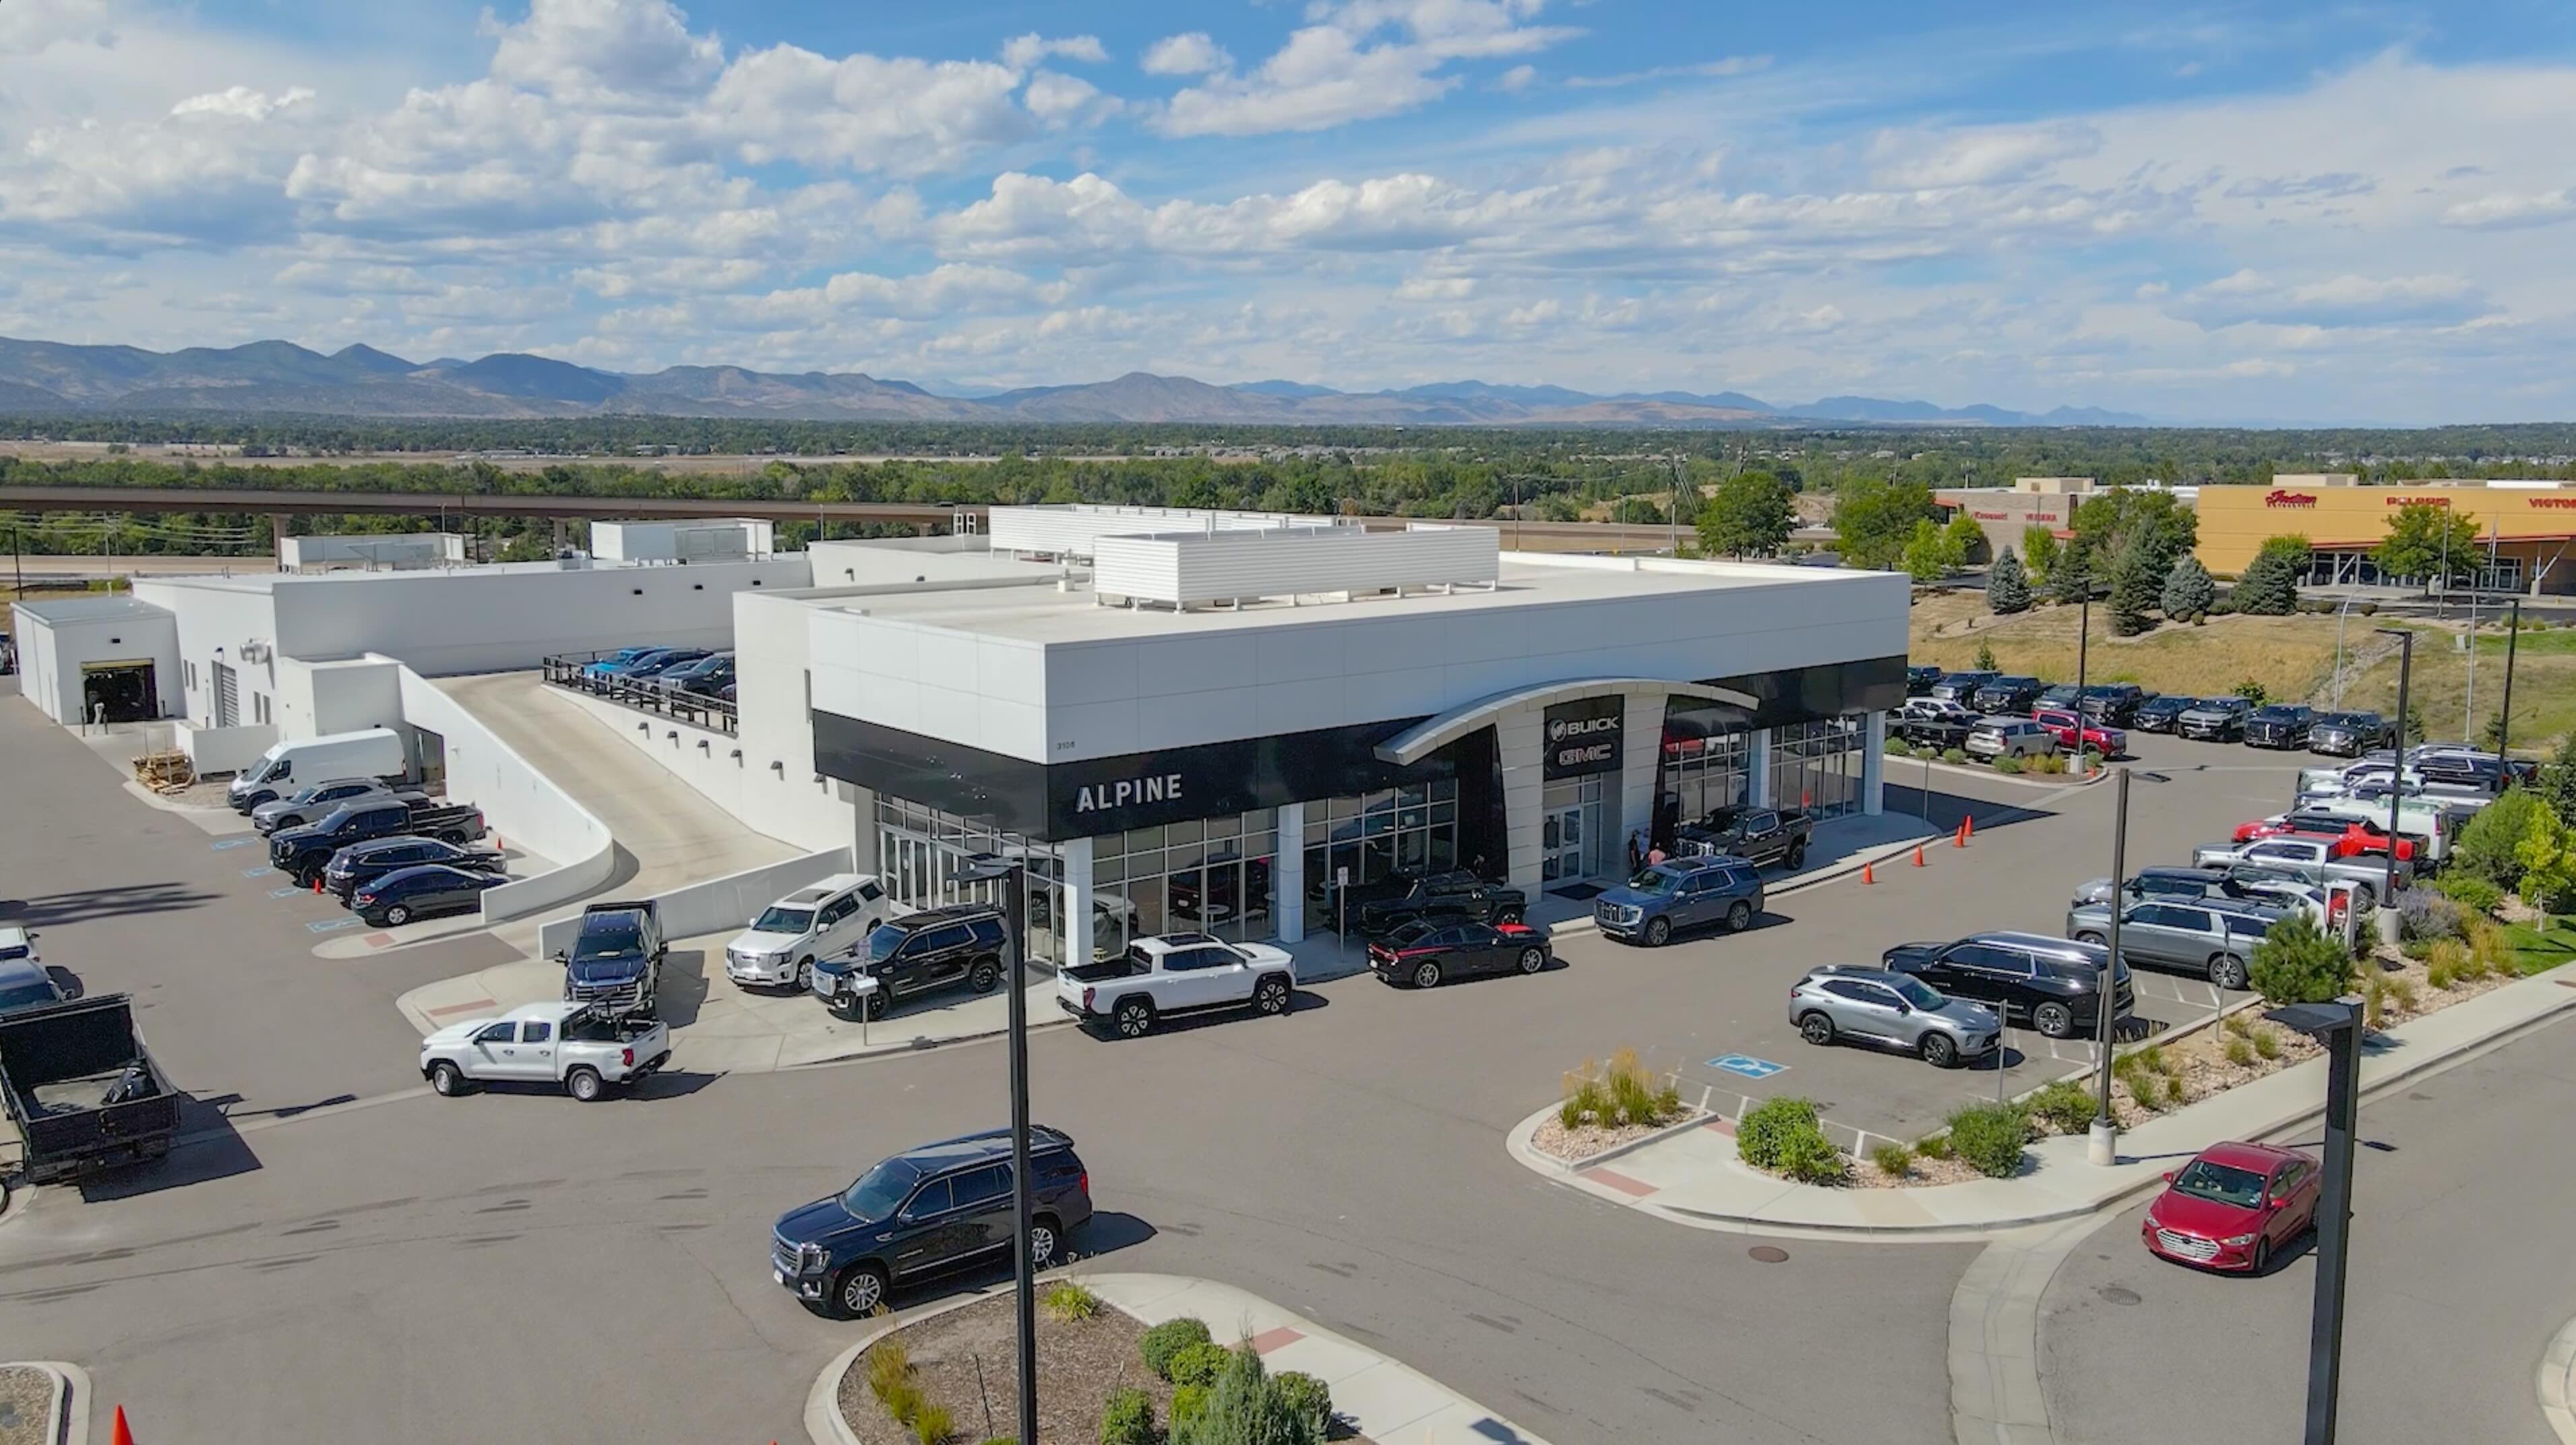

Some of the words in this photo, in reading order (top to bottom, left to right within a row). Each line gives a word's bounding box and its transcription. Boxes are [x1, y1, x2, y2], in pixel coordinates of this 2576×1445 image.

[2387, 497, 2449, 505] POLARIS
[1567, 716, 1619, 735] BUICK
[1559, 743, 1612, 766] GMC
[1076, 774, 1182, 813] ALPINE
